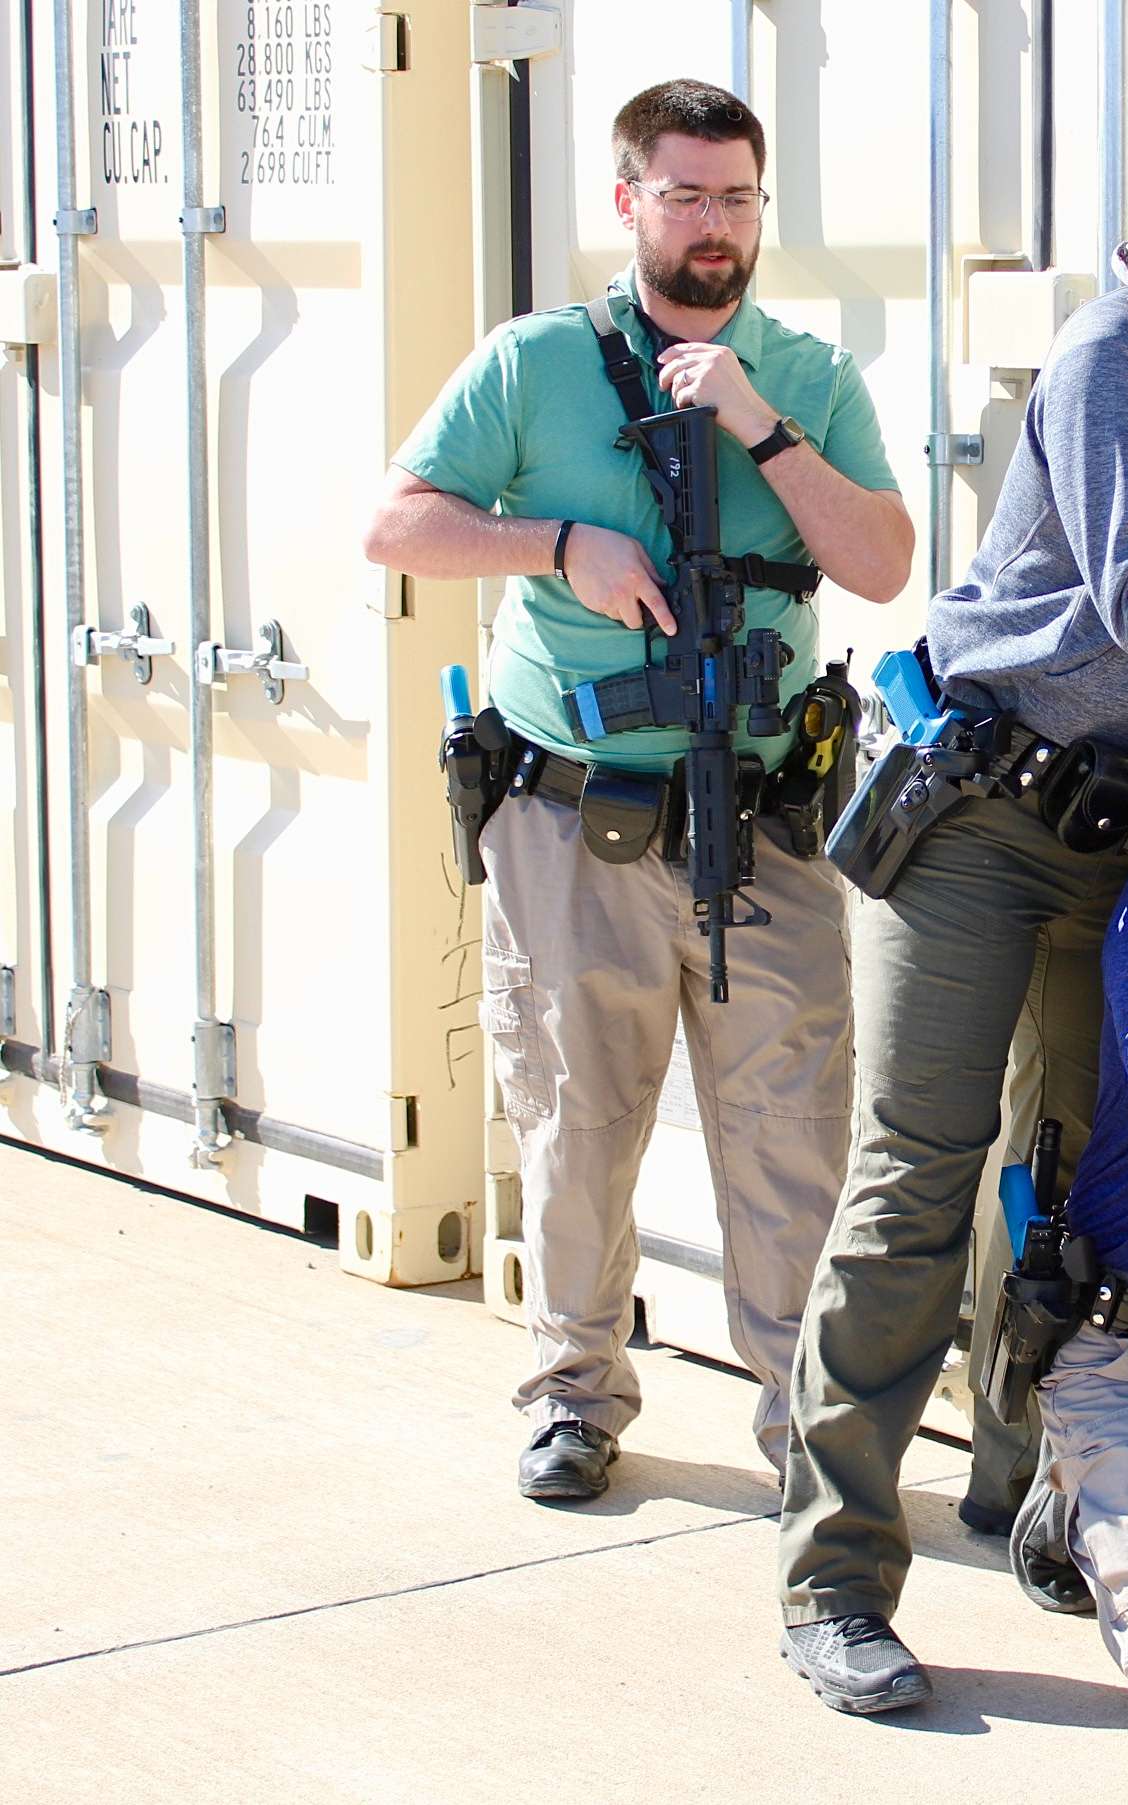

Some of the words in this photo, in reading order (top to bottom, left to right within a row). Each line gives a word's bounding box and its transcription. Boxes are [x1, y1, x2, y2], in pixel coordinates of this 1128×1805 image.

[304, 4, 331, 38] LBS
[305, 41, 332, 74] KGS
[101, 51, 131, 116] NET
[304, 78, 331, 111] LBS
[252, 115, 284, 148] 76.4
